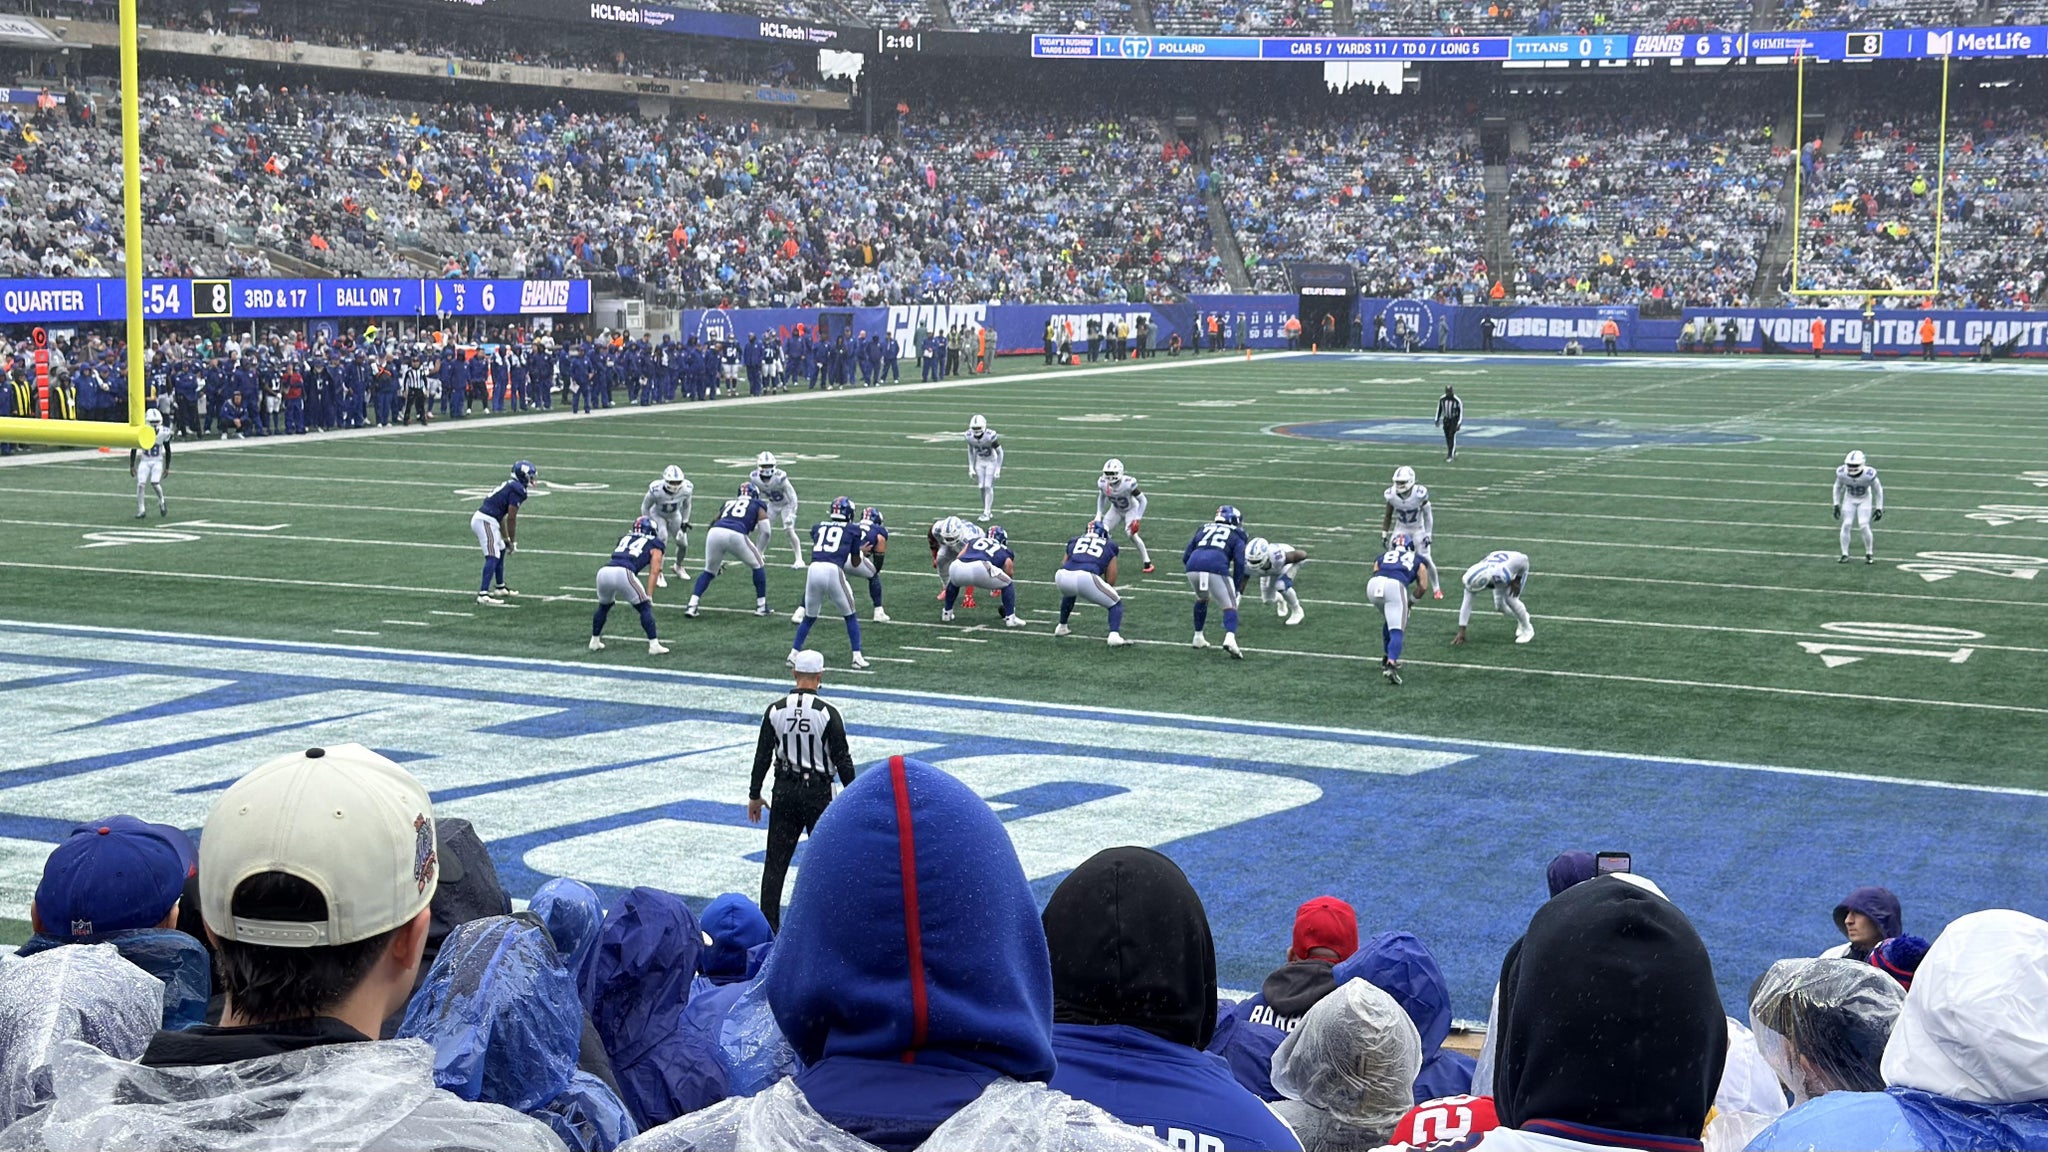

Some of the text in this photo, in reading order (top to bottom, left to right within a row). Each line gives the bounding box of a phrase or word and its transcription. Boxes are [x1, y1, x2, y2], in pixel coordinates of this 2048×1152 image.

[590, 4, 640, 23] HCLTech
[760, 22, 805, 40] HCLTech
[886, 36, 914, 48] 2:16
[1039, 38, 1093, 47] TODAY'S RUSHING
[1042, 47, 1091, 55] YARDS LEADERS
[1105, 42, 1205, 54] 1. POLLARD
[1290, 43, 1312, 54] CAR
[1315, 43, 1322, 54] 5
[1337, 43, 1371, 54] YARDS
[1374, 43, 1386, 54] 11
[1403, 43, 1415, 54] TD
[1418, 43, 1425, 54] 0
[1441, 43, 1469, 54] LONG
[1472, 43, 1479, 54] 5
[1516, 43, 1568, 53] TITANS
[1579, 38, 1591, 56] 0
[1605, 46, 1611, 56] 2
[1633, 36, 1683, 51] GIANTS
[1696, 37, 1709, 55] 6
[1723, 44, 1730, 54] 3
[1760, 38, 1784, 49] HMH
[1863, 36, 1877, 52] 8
[1957, 33, 2031, 51] MetLife
[636, 81, 670, 93] verizon
[336, 288, 401, 307] BALL ON 7
[453, 283, 466, 294] TOL
[521, 280, 570, 306] GIANTS
[5, 290, 84, 314] QUARTER
[212, 284, 226, 313] 8
[244, 288, 306, 308] 3RD & 17
[456, 296, 464, 311] 3
[482, 284, 495, 312] 6
[1507, 317, 1547, 337] BIG
[1965, 320, 2048, 346] GIANT
[721, 498, 750, 518] 78
[1396, 508, 1418, 524] 37
[615, 534, 648, 558] 44
[812, 526, 843, 553] 19
[1198, 526, 1230, 549] 72
[973, 537, 997, 557] 61
[1072, 536, 1106, 558] 65
[1383, 550, 1416, 571] 84
[1797, 621, 1986, 663] 10
[794, 708, 802, 717] R
[786, 717, 811, 733] 76
